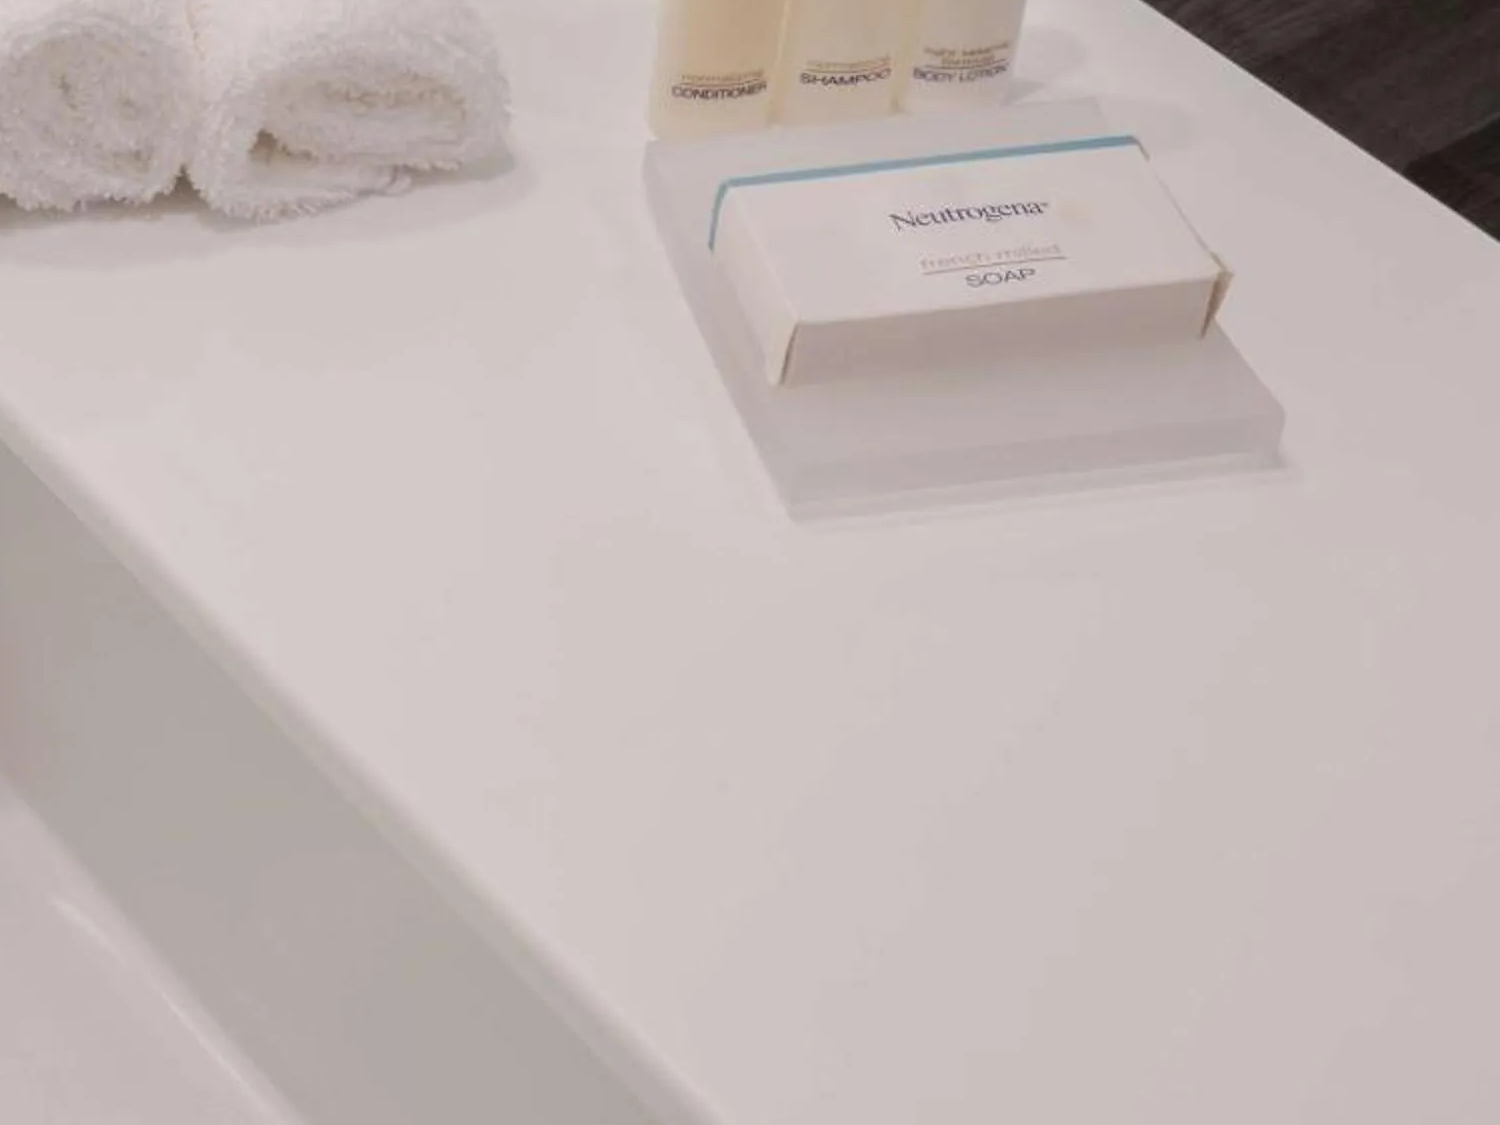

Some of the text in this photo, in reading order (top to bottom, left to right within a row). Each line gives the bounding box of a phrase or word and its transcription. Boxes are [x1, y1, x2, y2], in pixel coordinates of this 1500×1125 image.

[800, 68, 891, 86] SHAMPOO
[671, 81, 767, 99] CONDITIONER
[965, 268, 1036, 288] SOAP
